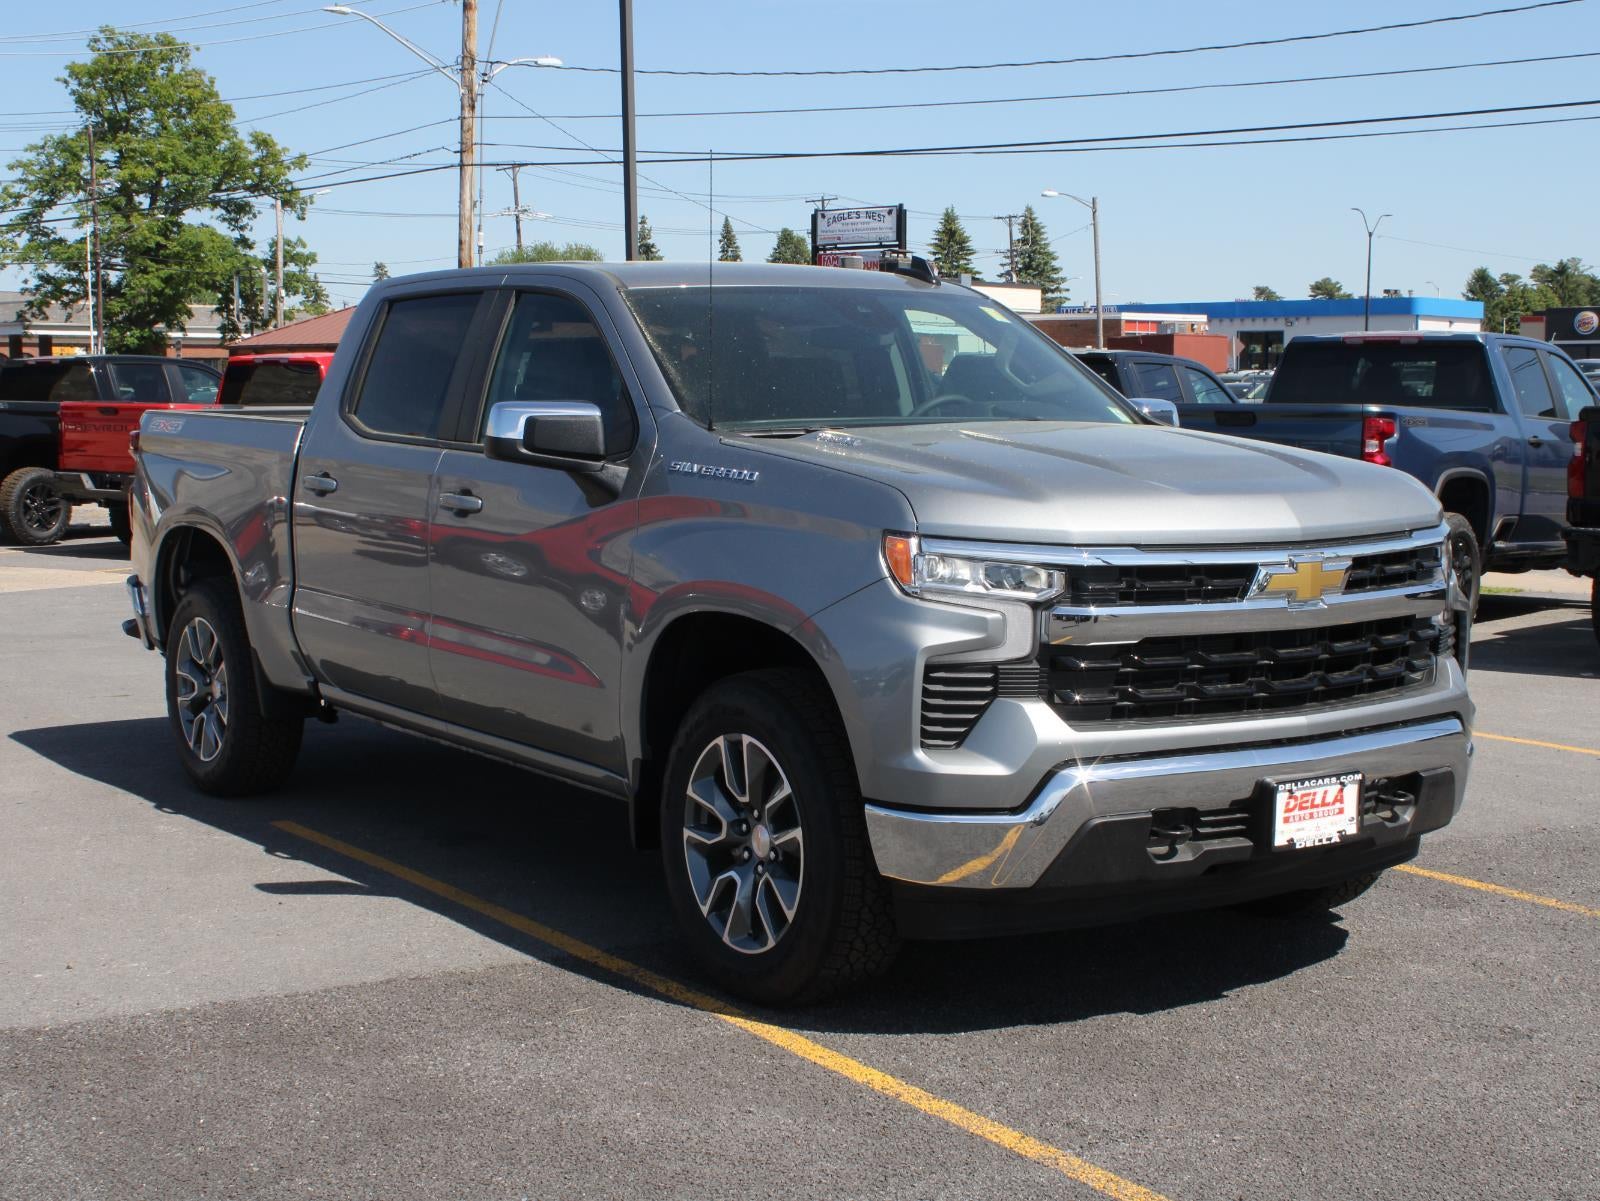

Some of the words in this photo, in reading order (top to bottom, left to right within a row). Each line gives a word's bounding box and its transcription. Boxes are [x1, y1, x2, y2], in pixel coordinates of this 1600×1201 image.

[826, 211, 861, 227] EAGLE'S
[865, 210, 886, 224] NEST
[669, 461, 760, 482] SILVERADO
[1278, 773, 1362, 791] DELLACARS.COM
[1284, 789, 1344, 812] DELLA
[1289, 812, 1310, 823] AUTO
[1312, 808, 1340, 821] GROUP
